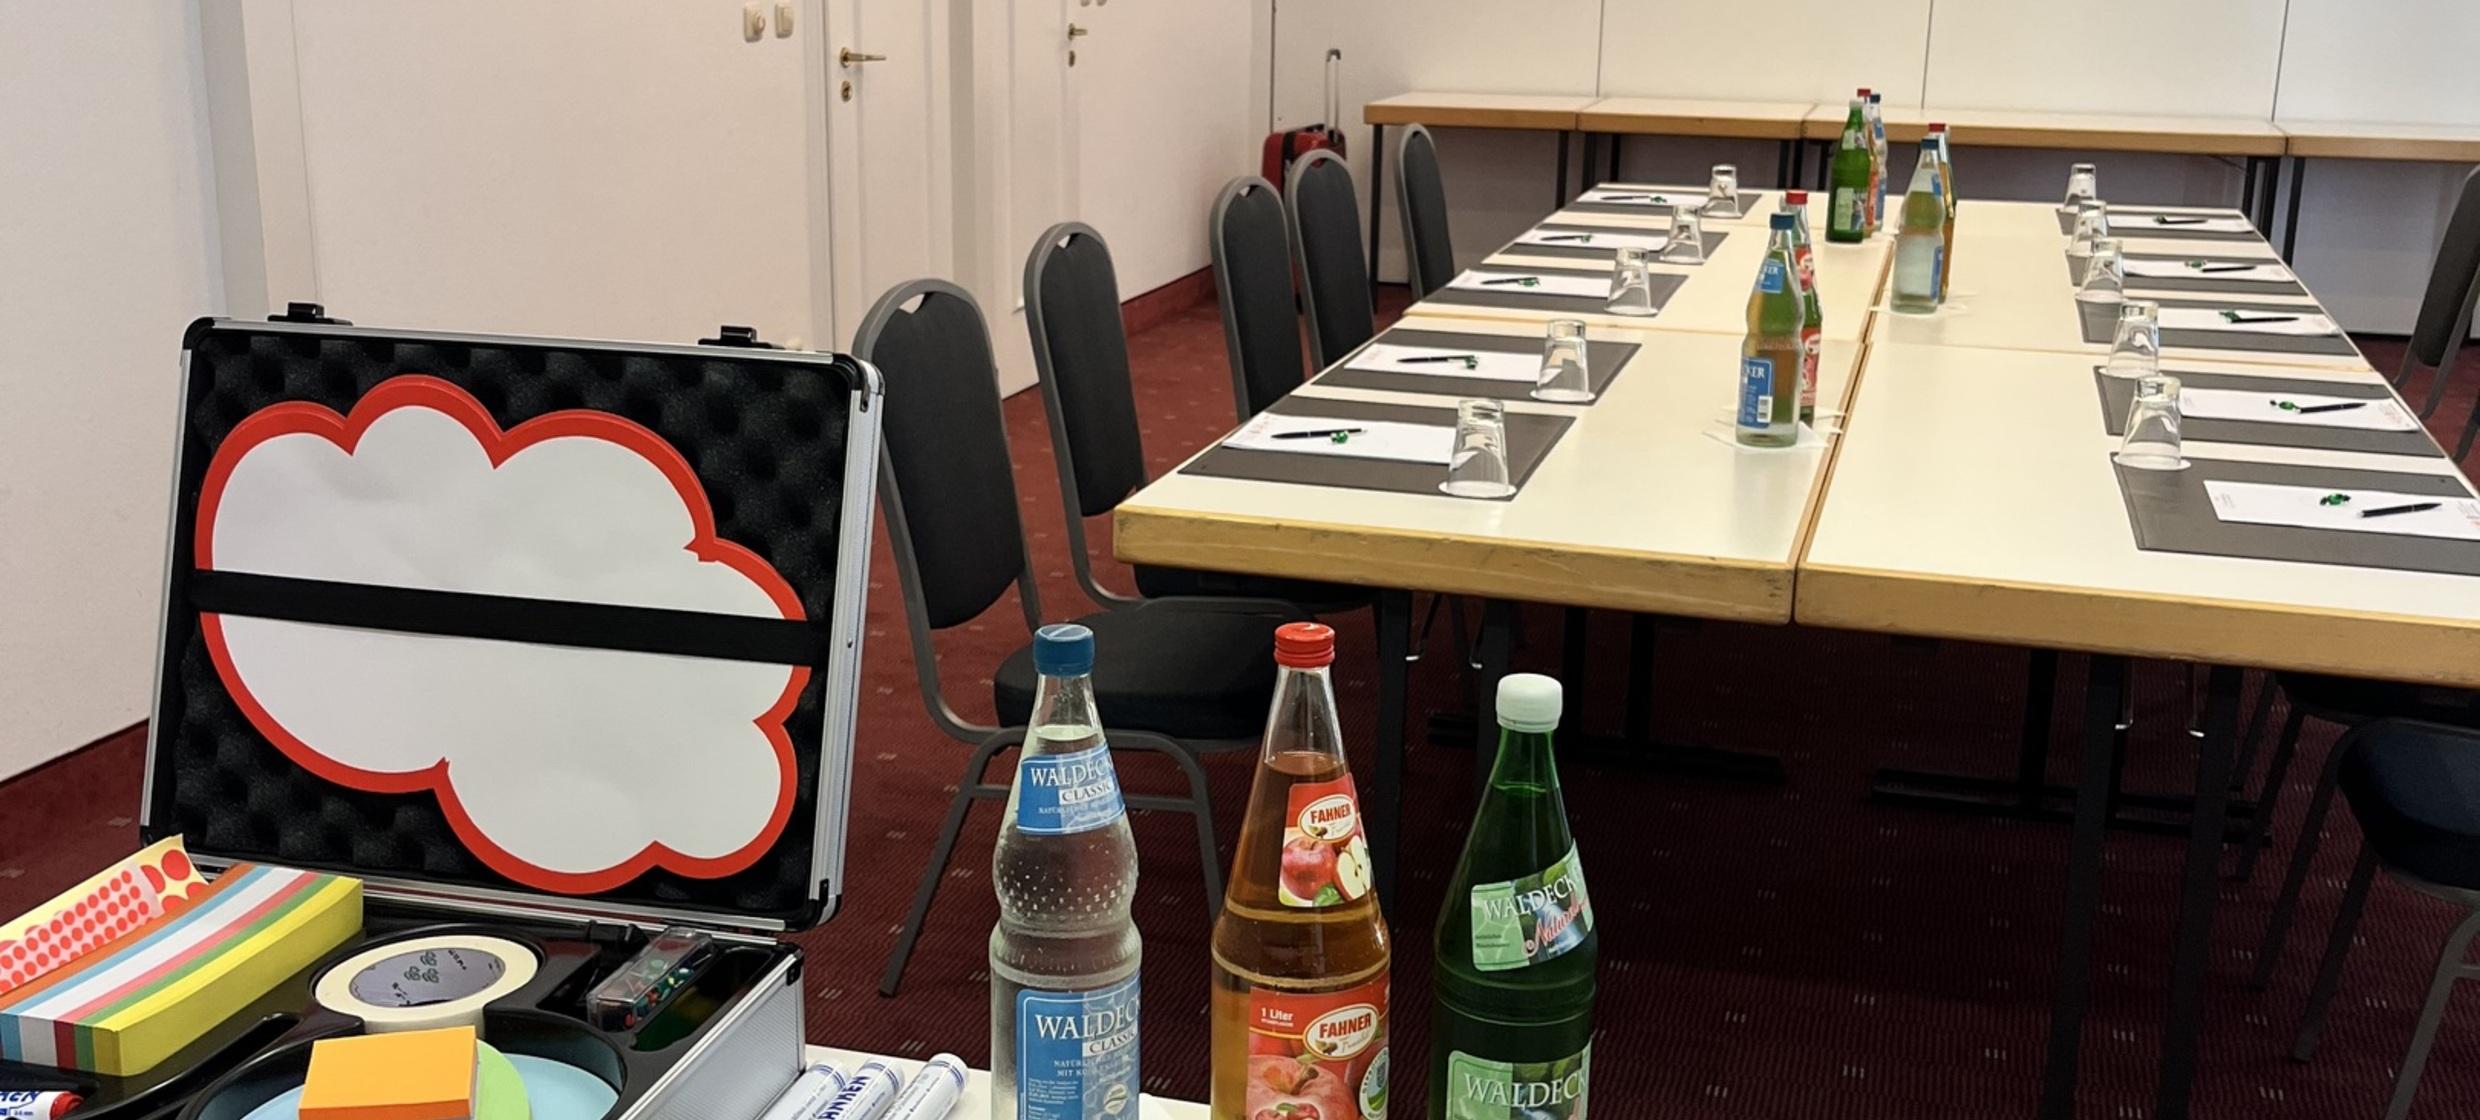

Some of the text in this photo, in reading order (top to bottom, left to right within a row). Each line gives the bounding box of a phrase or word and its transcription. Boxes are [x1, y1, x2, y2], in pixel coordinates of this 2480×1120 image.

[1310, 803, 1351, 824] FAHNER
[1261, 1007, 1293, 1021] 1 Liter
[1319, 1013, 1371, 1038] FAHNER
[818, 1075, 871, 1120] ANKEN
